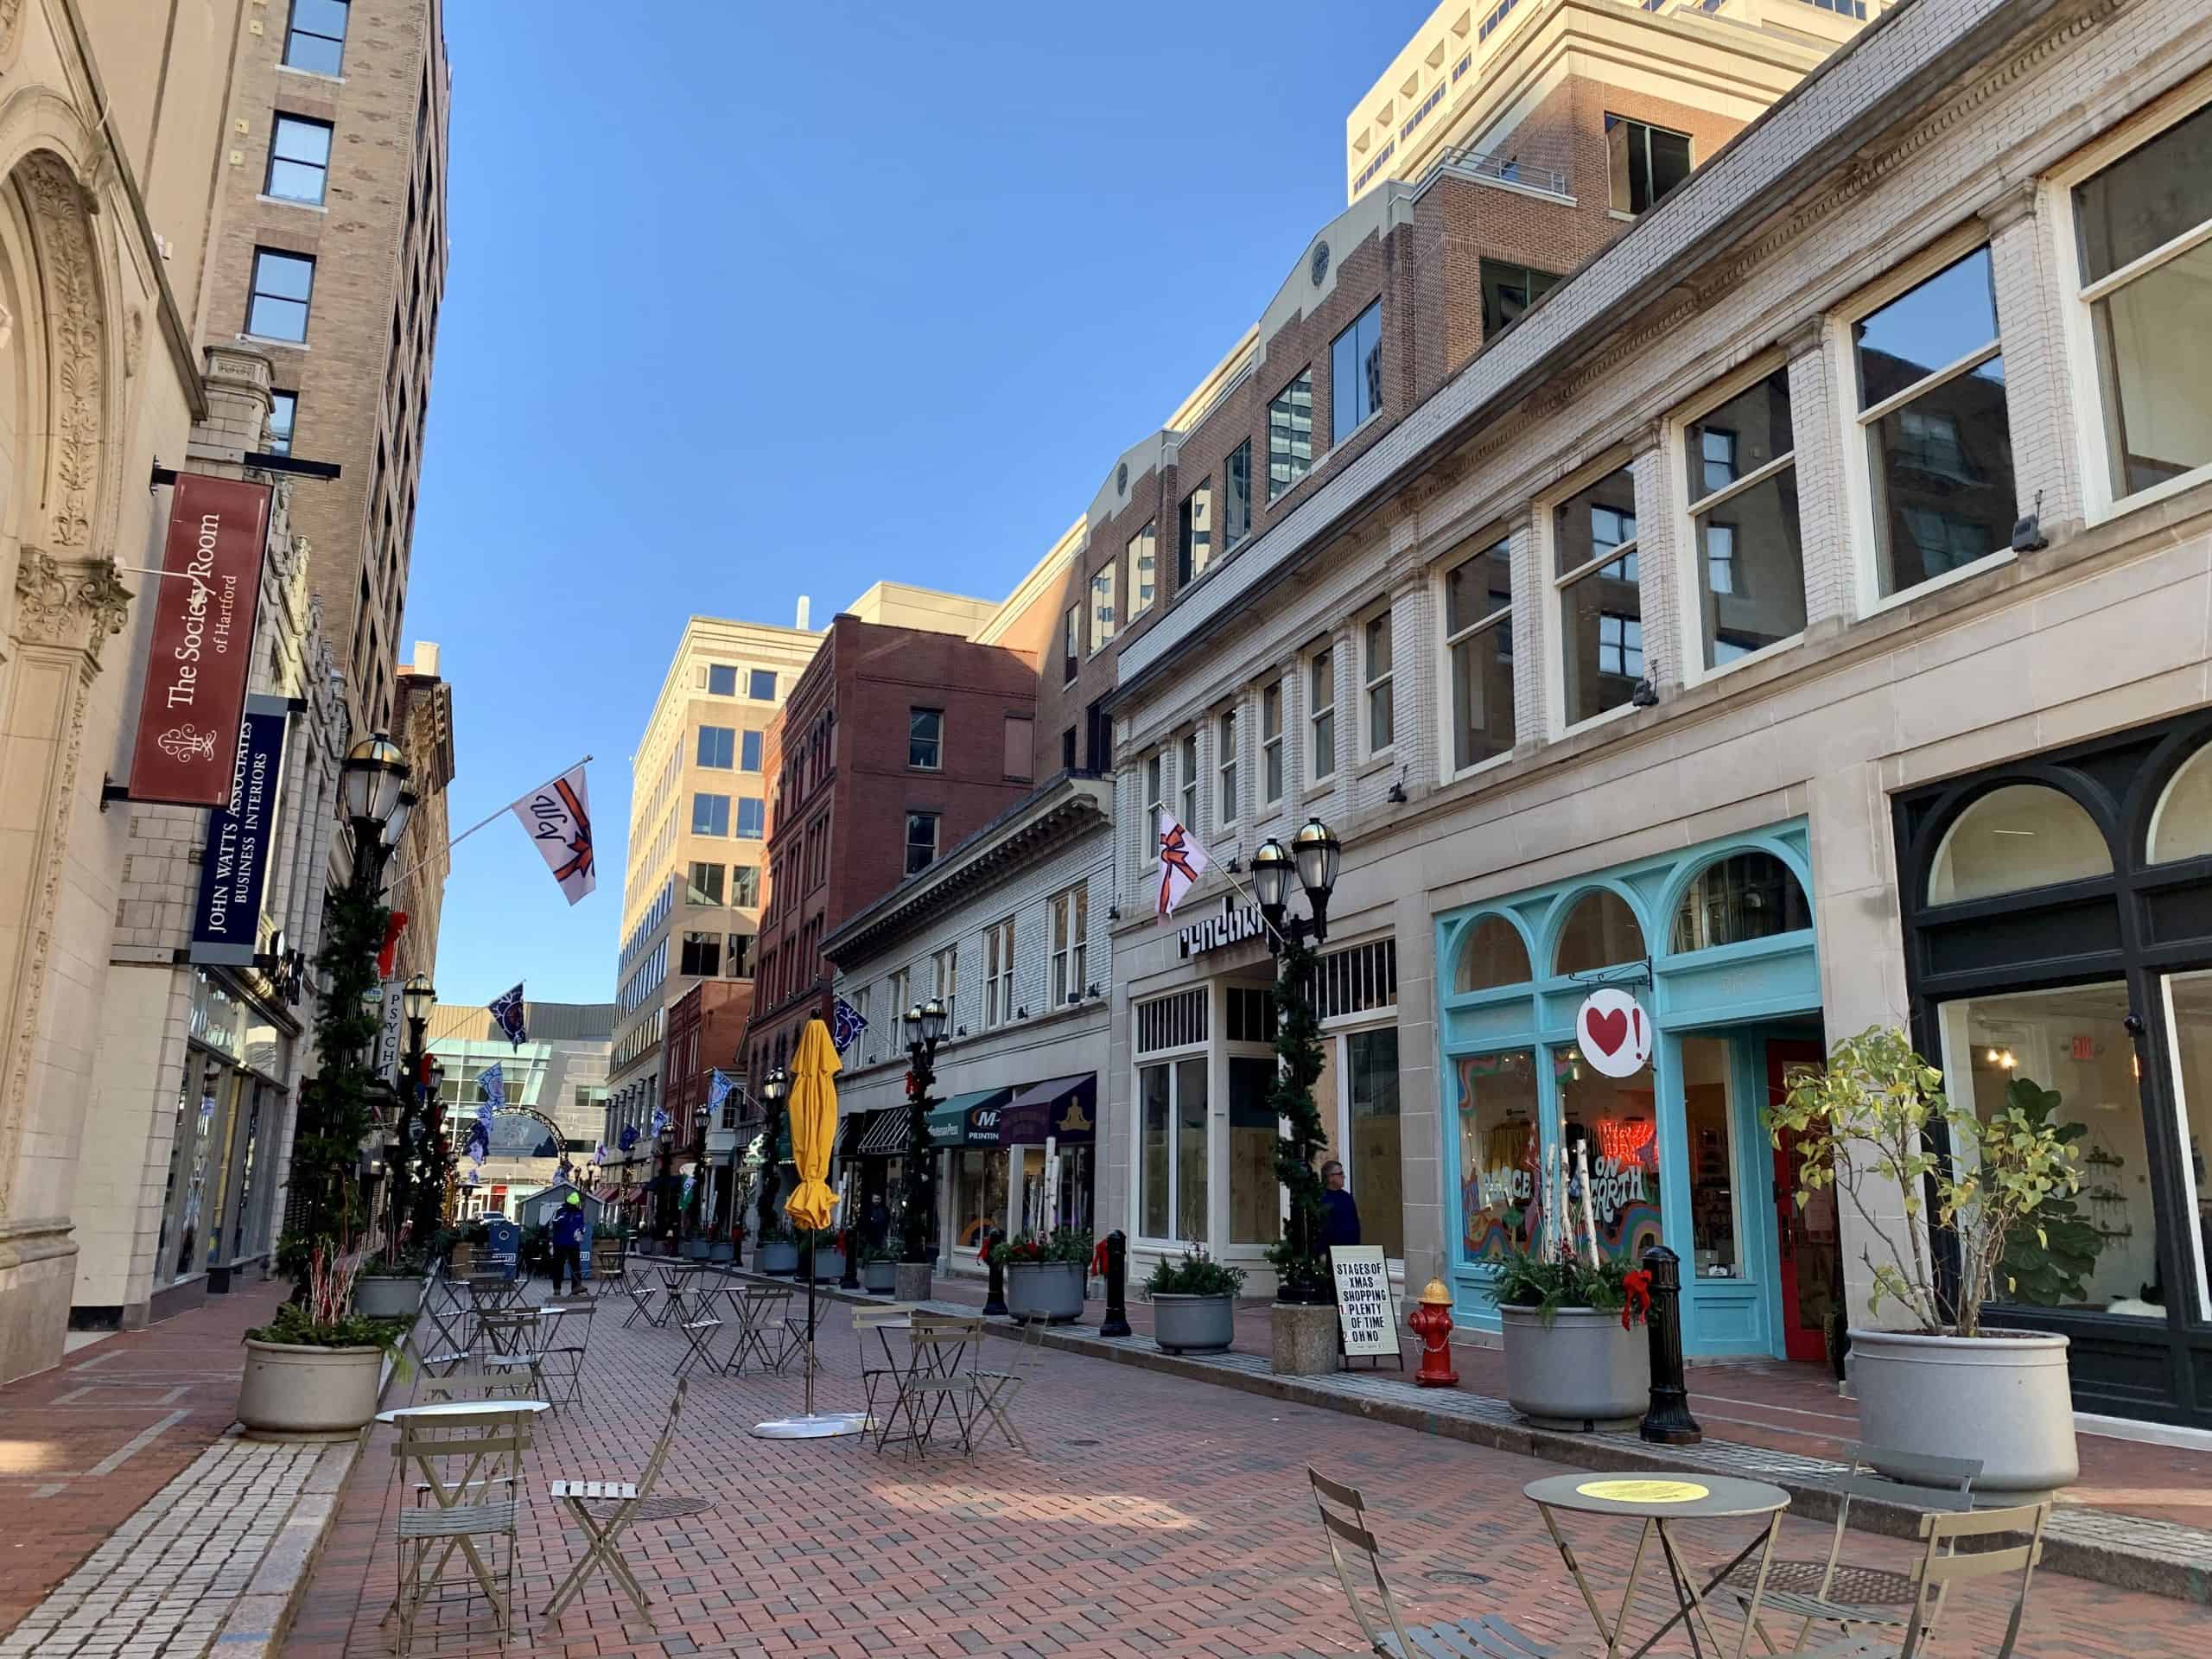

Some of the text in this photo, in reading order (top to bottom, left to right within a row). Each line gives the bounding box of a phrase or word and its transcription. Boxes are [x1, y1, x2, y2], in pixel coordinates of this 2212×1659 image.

[167, 514, 219, 709] The Society Room
[213, 575, 237, 653] of Hartford
[208, 722, 252, 934] JOHN WATTS ASSOCIATES
[235, 753, 267, 904] BUSINESS INTERIORS
[969, 1131, 1000, 1141] PRINTIN
[1595, 1156, 1621, 1179] ON
[1337, 1263, 1382, 1275] STAGES OF
[1349, 1277, 1374, 1288] XMAS
[1344, 1290, 1387, 1302] SHOPPING
[1349, 1304, 1382, 1315] PLENTY
[1351, 1317, 1385, 1329] OF TIME
[1352, 1331, 1365, 1343] OH
[1367, 1331, 1379, 1342] NO
